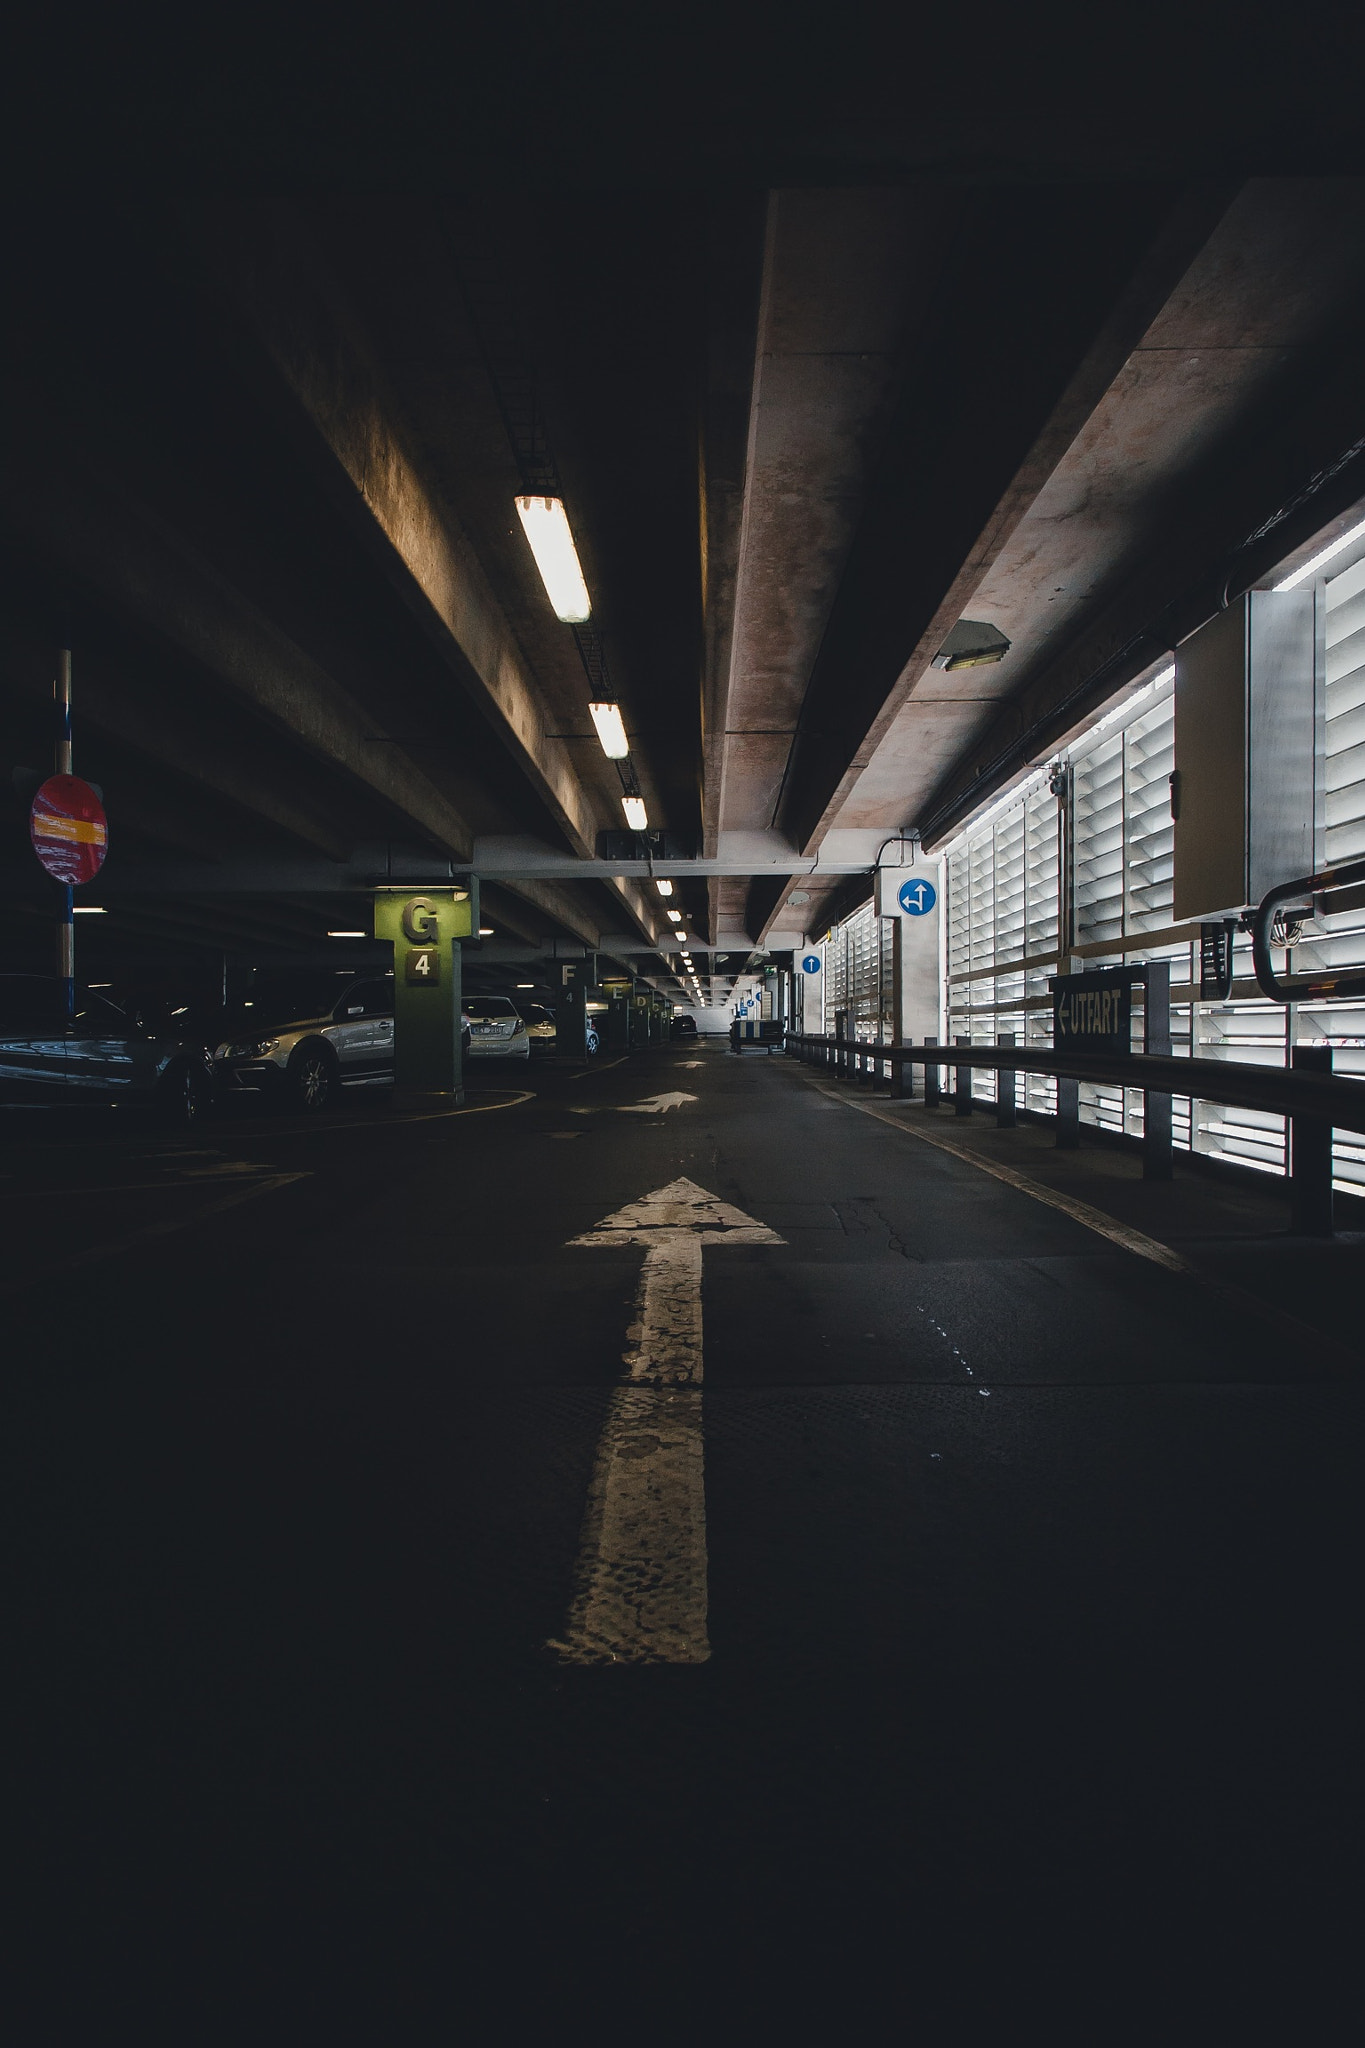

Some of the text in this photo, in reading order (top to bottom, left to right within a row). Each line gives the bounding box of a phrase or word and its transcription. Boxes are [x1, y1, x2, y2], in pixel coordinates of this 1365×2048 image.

[403, 897, 438, 944] G
[415, 955, 430, 975] 4
[562, 964, 576, 986] F
[566, 992, 573, 1003] 4
[612, 986, 623, 999] E
[636, 996, 646, 1007] D
[1070, 989, 1121, 1034] UTFART
